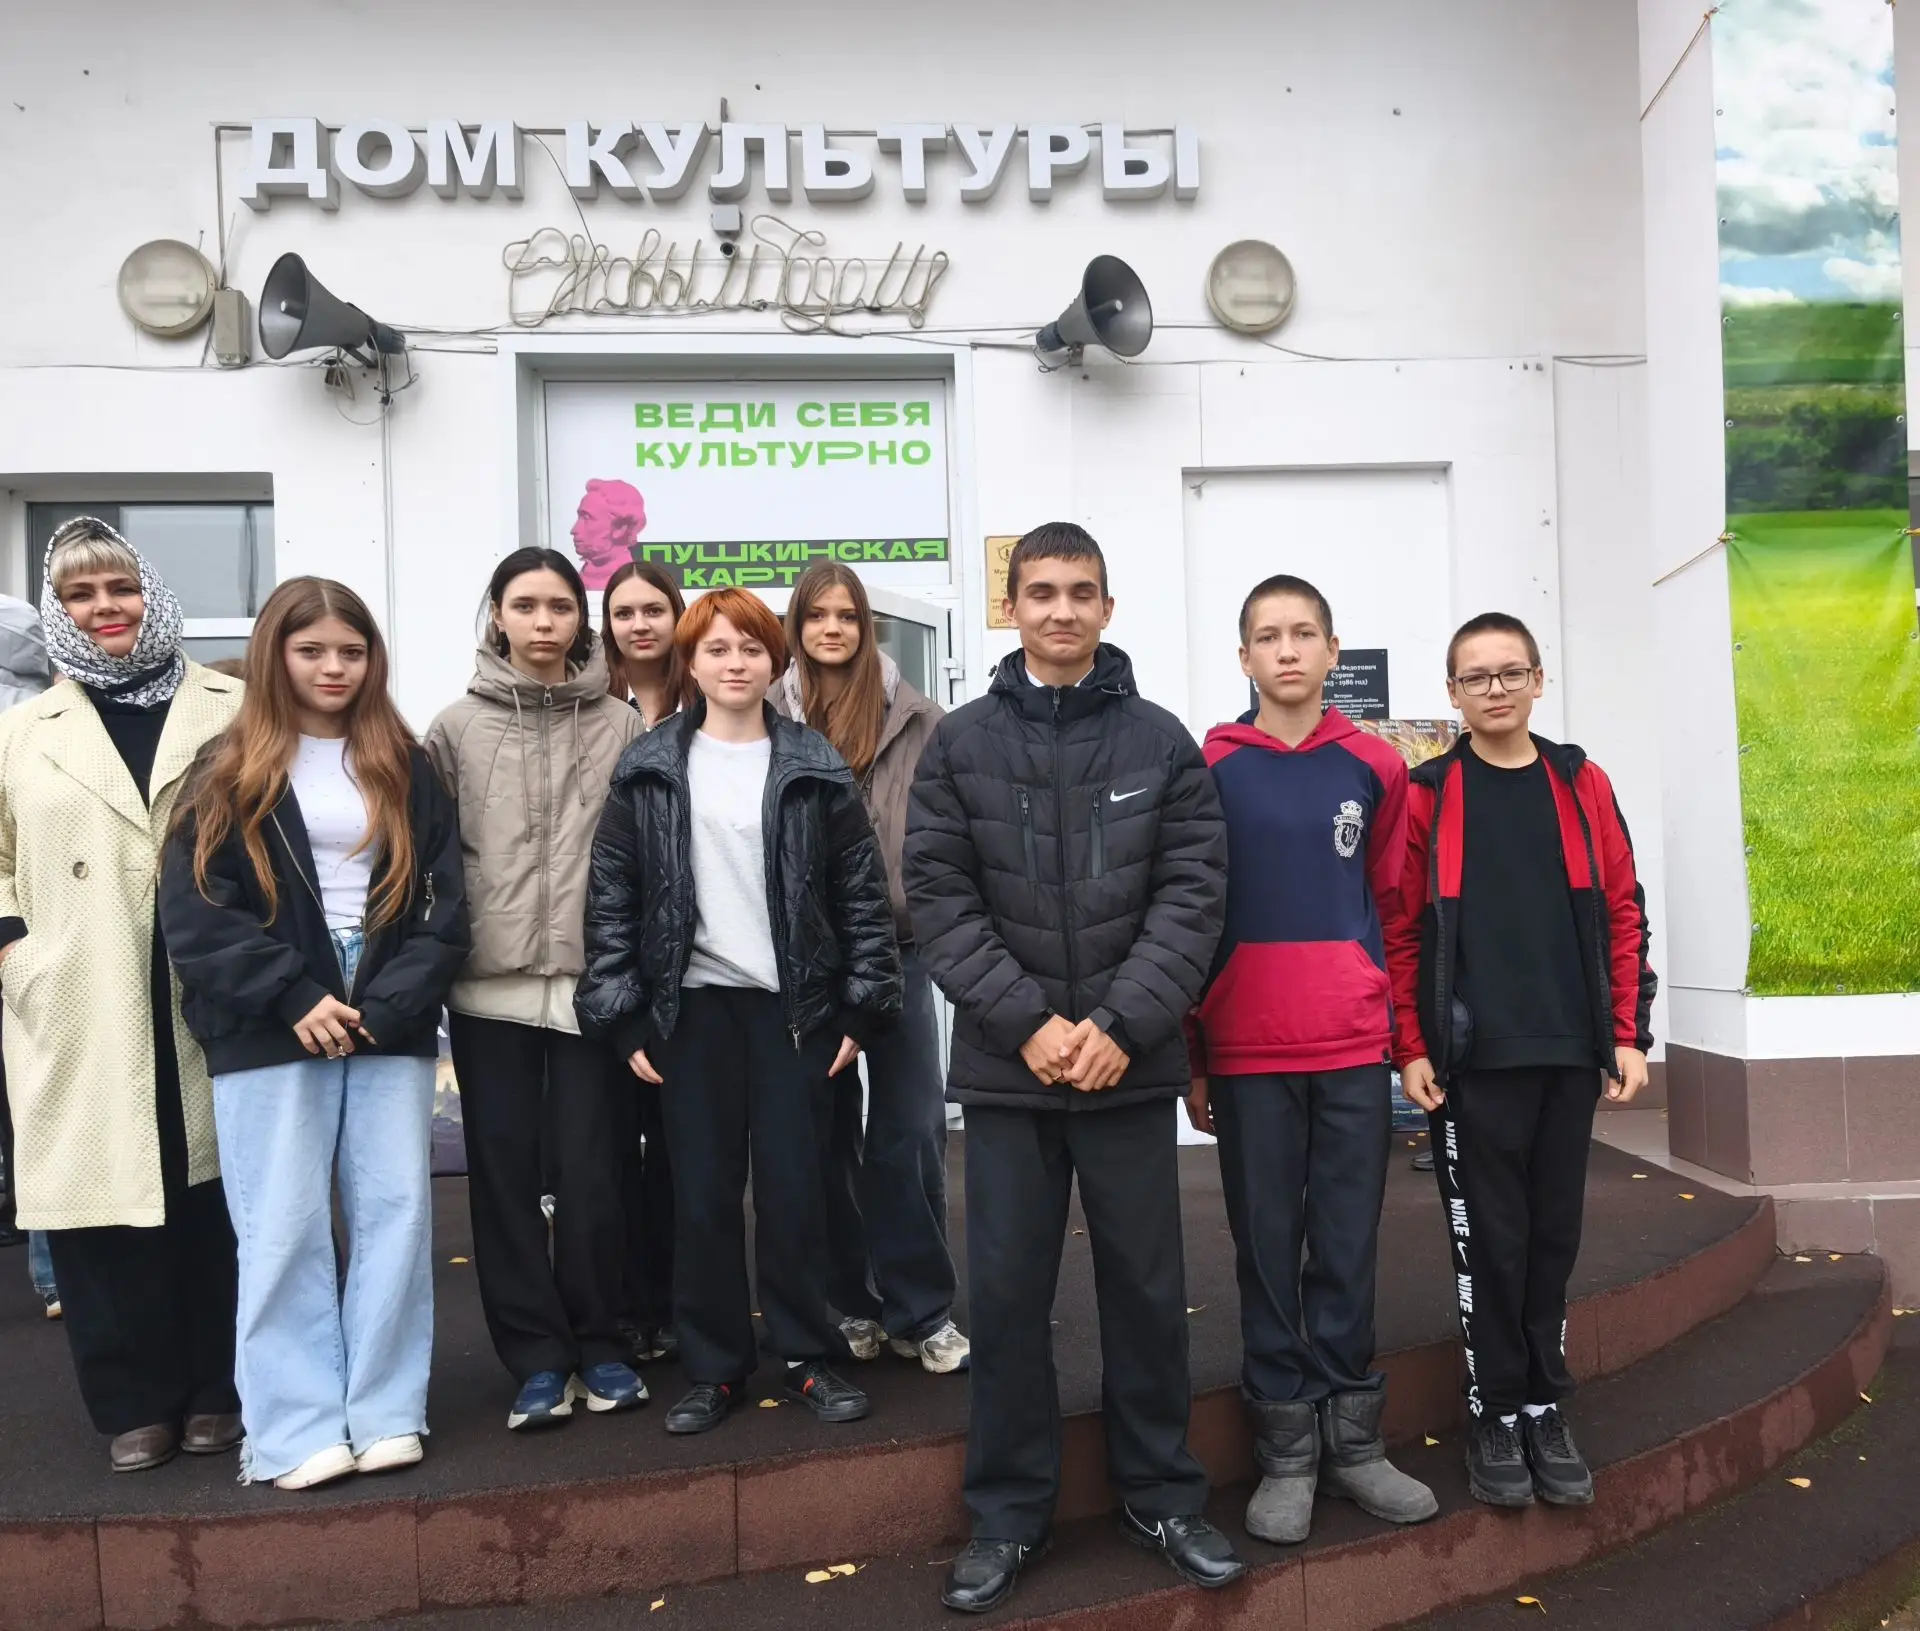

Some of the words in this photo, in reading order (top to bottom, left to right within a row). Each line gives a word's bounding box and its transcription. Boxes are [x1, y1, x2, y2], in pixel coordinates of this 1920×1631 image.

[240, 117, 523, 210] ДОМ
[565, 120, 1202, 205] КУЛЬТУРЫ
[634, 402, 776, 433] ВЕДИ
[796, 401, 931, 428] СЕБЯ
[635, 440, 932, 469] КУЛЬТУРНО
[642, 540, 945, 564] ПУШКИНСКАЯ
[683, 566, 801, 587] КАРТ
[1444, 1120, 1458, 1161] NIKE
[1450, 1198, 1470, 1237] NIKE
[1457, 1272, 1473, 1313] NIKE
